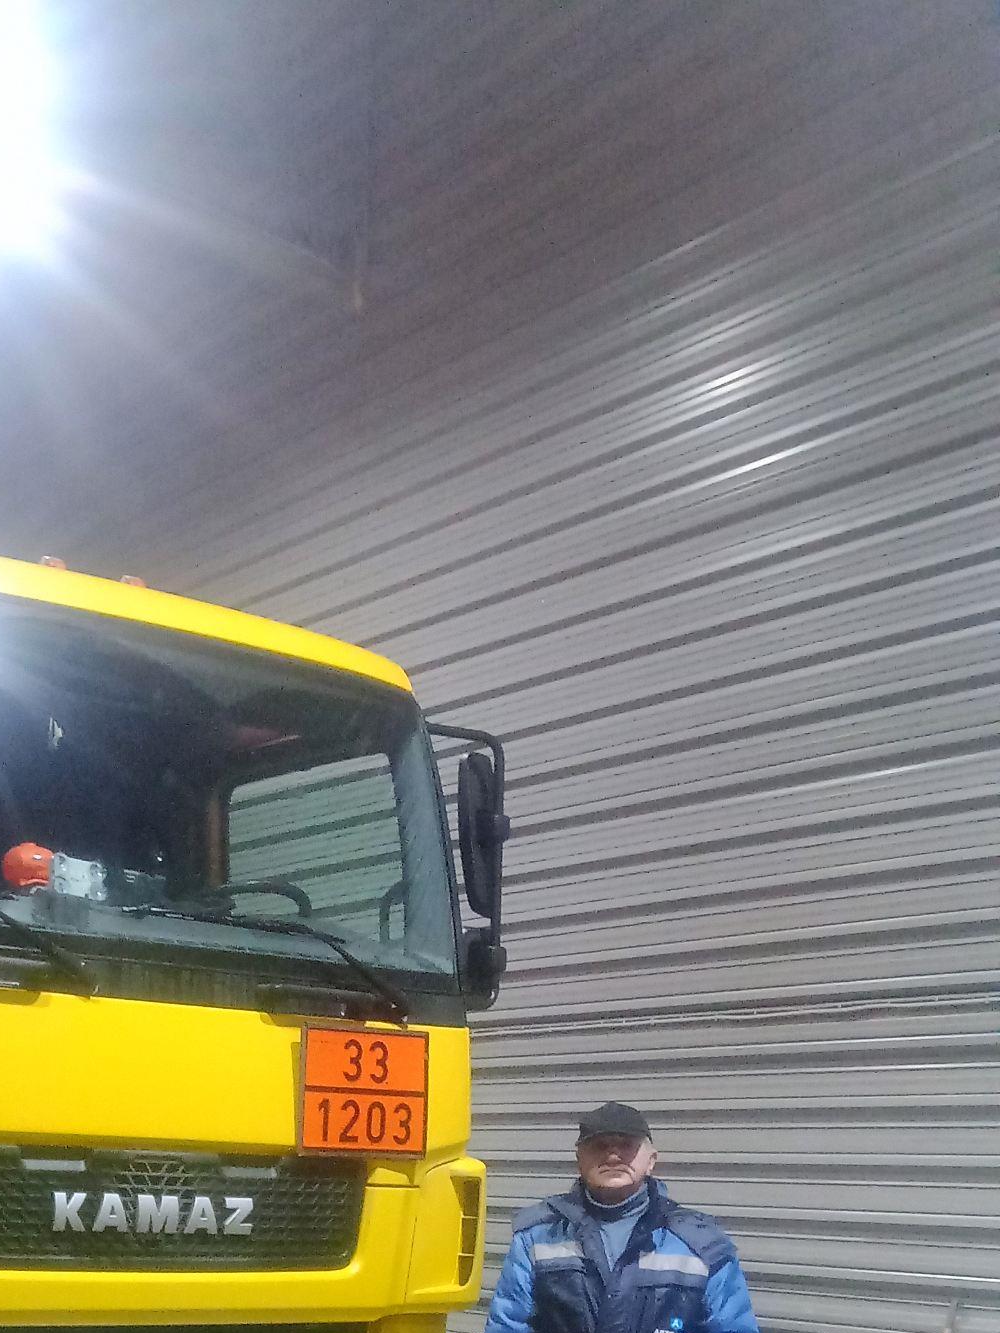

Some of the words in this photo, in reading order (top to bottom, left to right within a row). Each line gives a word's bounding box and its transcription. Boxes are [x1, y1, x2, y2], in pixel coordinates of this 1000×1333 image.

[343, 1039, 389, 1084] 33
[319, 1098, 412, 1145] 1203
[53, 1191, 253, 1235] KAMAZ
